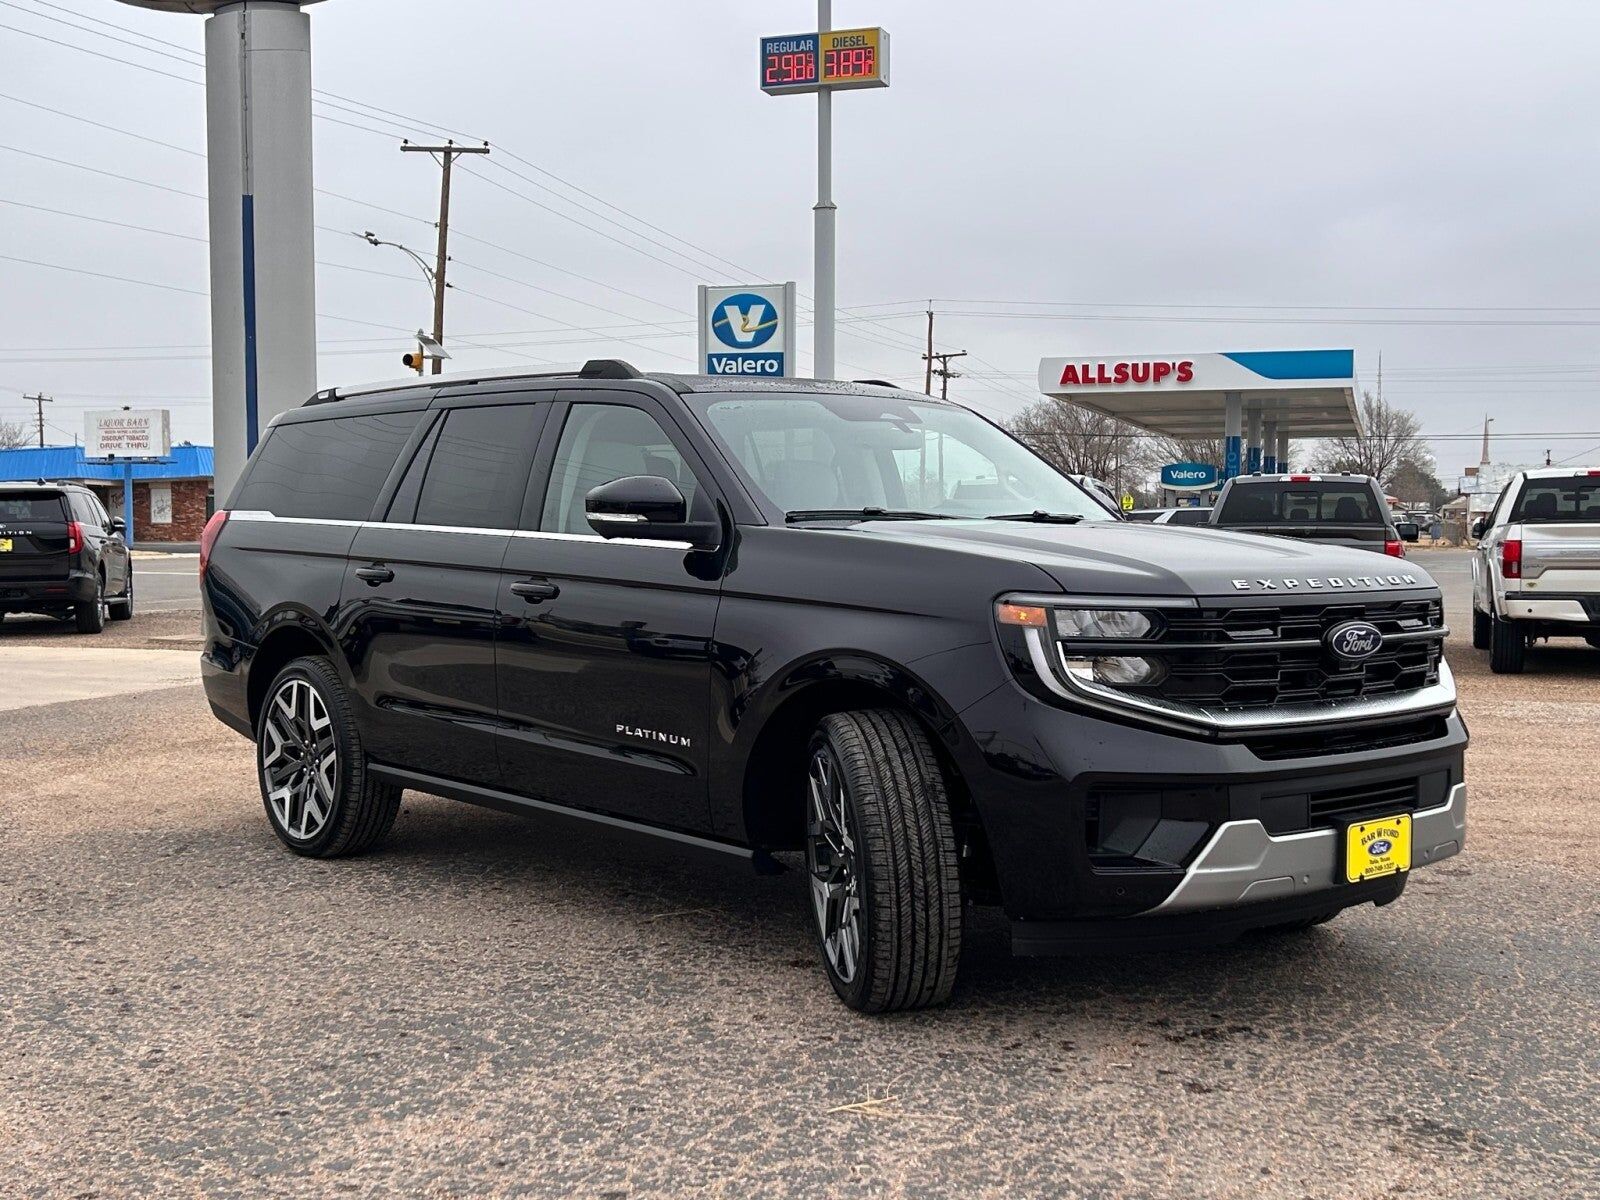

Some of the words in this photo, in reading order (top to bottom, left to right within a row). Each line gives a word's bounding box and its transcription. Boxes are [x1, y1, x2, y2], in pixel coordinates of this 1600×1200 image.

[766, 39, 814, 54] REGULAR
[832, 35, 868, 48] DIESEL
[711, 357, 779, 374] Valero
[1059, 360, 1194, 386] ALLSUP'S
[99, 418, 124, 427] LIQUOR
[127, 417, 149, 427] BARN
[1170, 470, 1206, 479] Valero
[1231, 574, 1417, 590] EXPEDITION
[1342, 629, 1374, 653] Ford
[615, 724, 691, 748] PLATINUM
[1360, 832, 1376, 846] BAR
[1376, 827, 1383, 838] W
[1383, 828, 1400, 839] FORD
